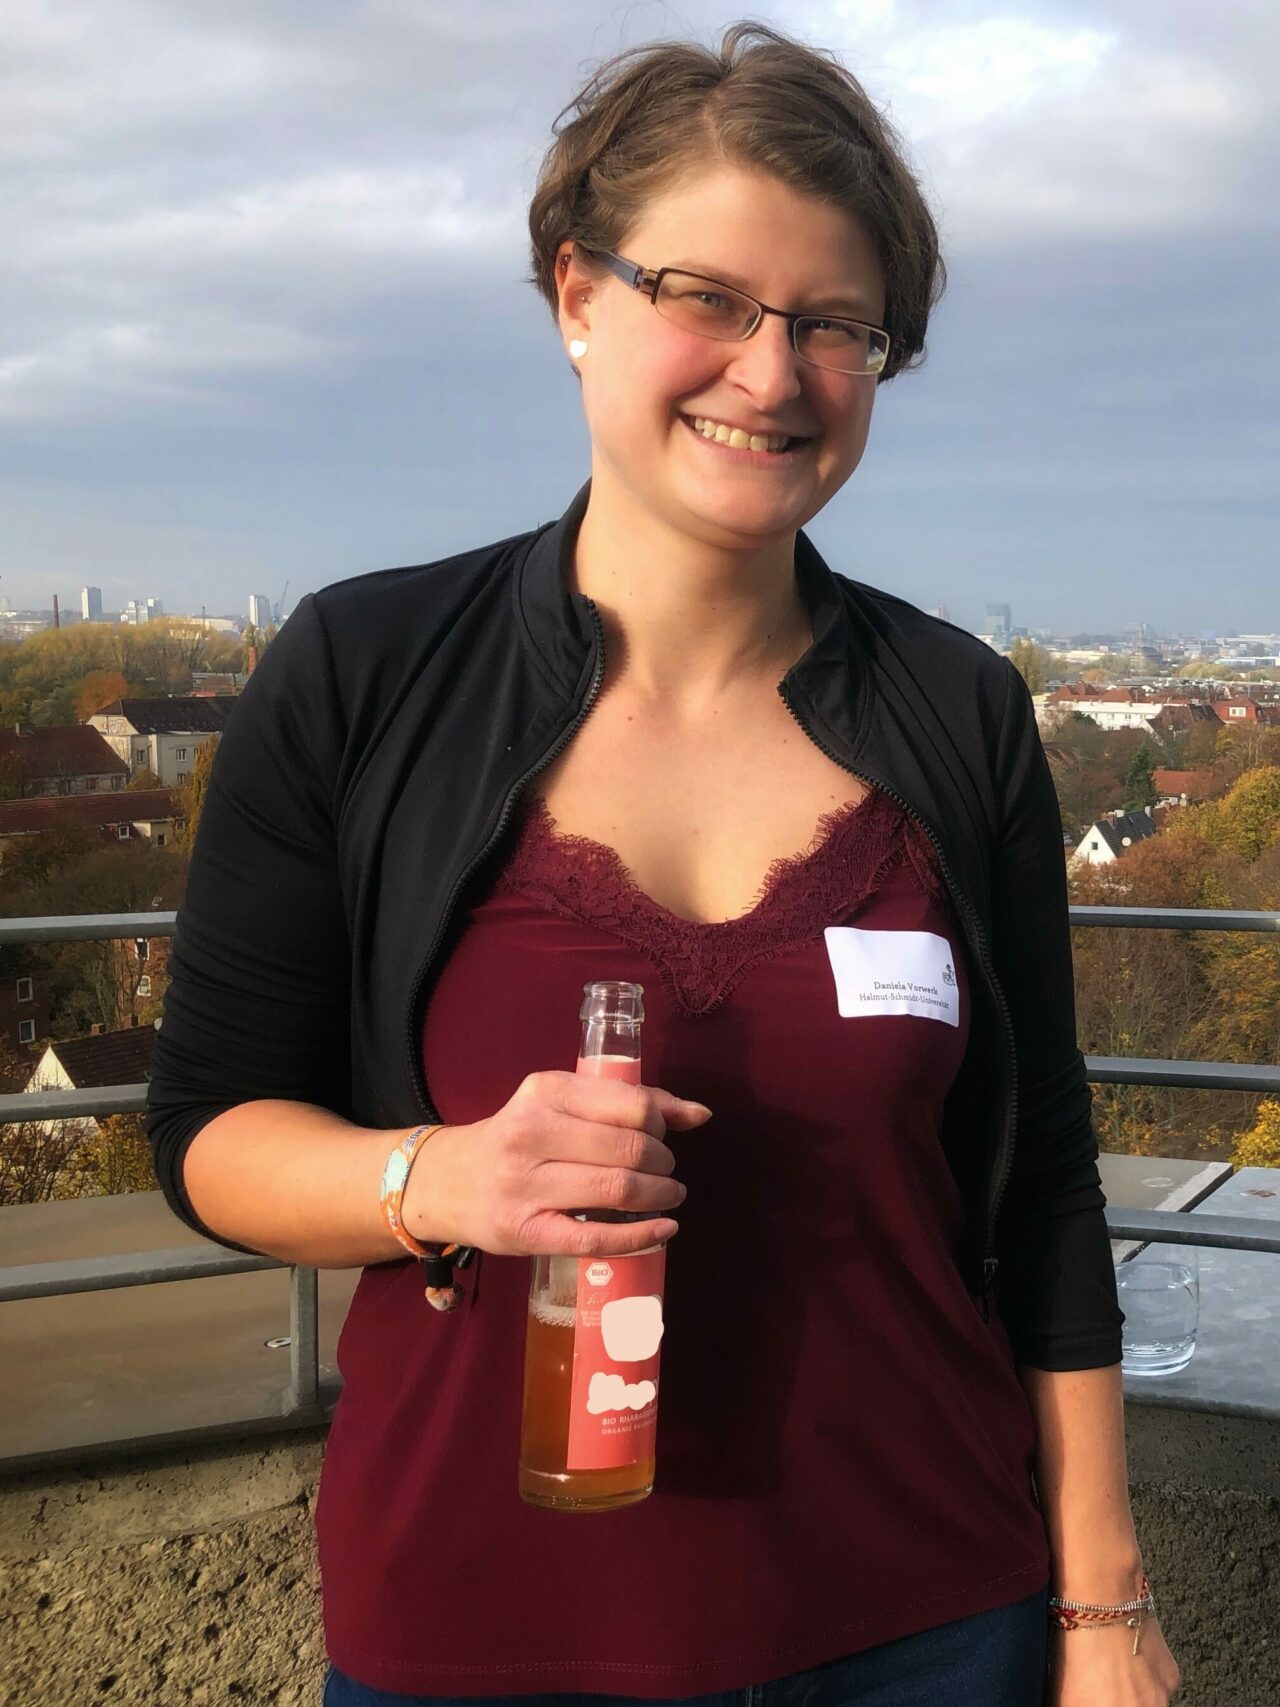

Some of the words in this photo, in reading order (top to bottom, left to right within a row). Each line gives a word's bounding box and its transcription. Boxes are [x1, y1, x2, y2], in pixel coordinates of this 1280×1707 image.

[873, 981, 906, 990] Daniela
[907, 982, 938, 995] Vorwerk
[591, 1269, 608, 1277] BIO
[602, 1416, 617, 1426] BIO
